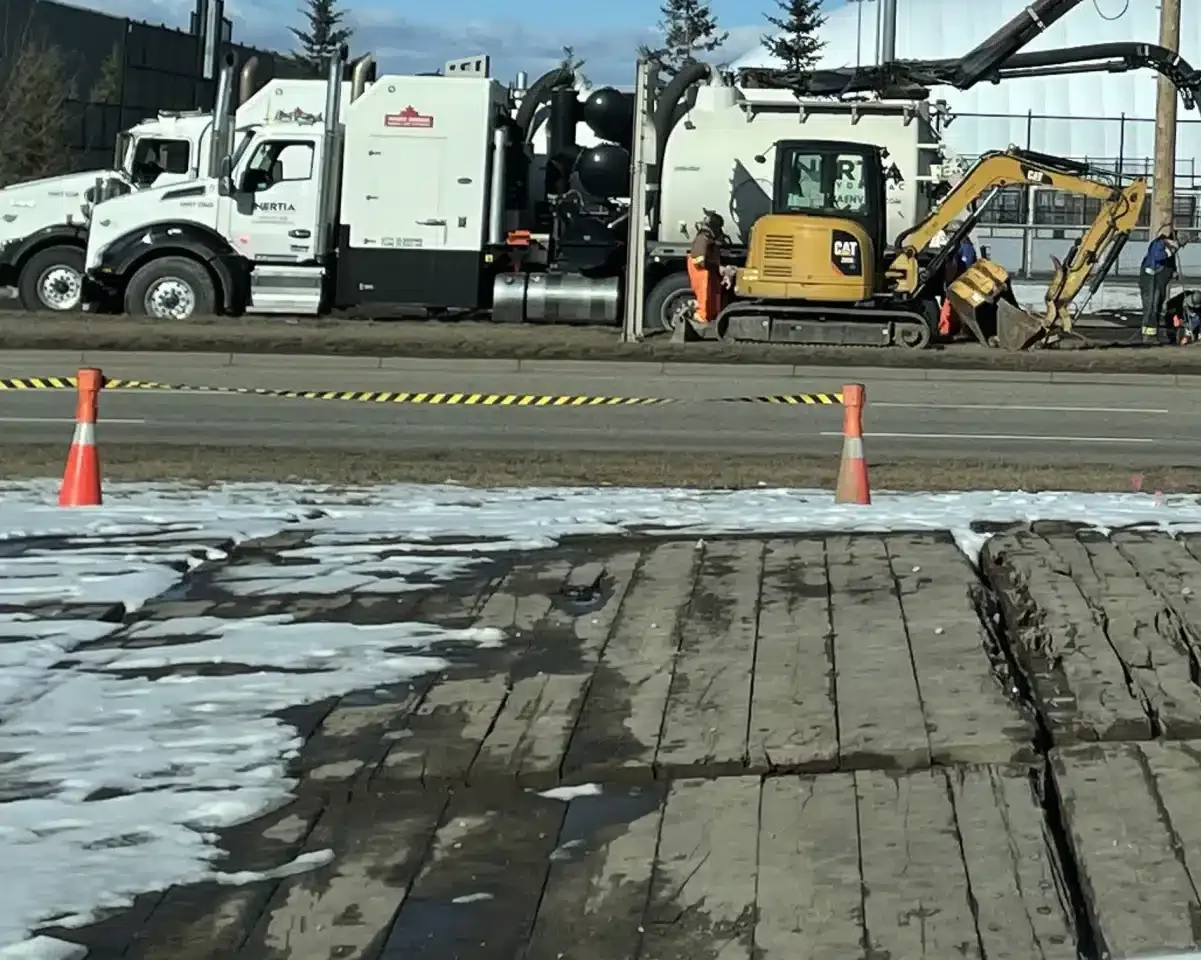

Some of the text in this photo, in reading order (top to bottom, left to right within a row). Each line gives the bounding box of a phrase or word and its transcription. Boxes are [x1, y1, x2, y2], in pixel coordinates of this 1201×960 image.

[1027, 170, 1043, 181] CAT
[254, 201, 296, 211] NERTIA
[834, 241, 858, 256] CAT
